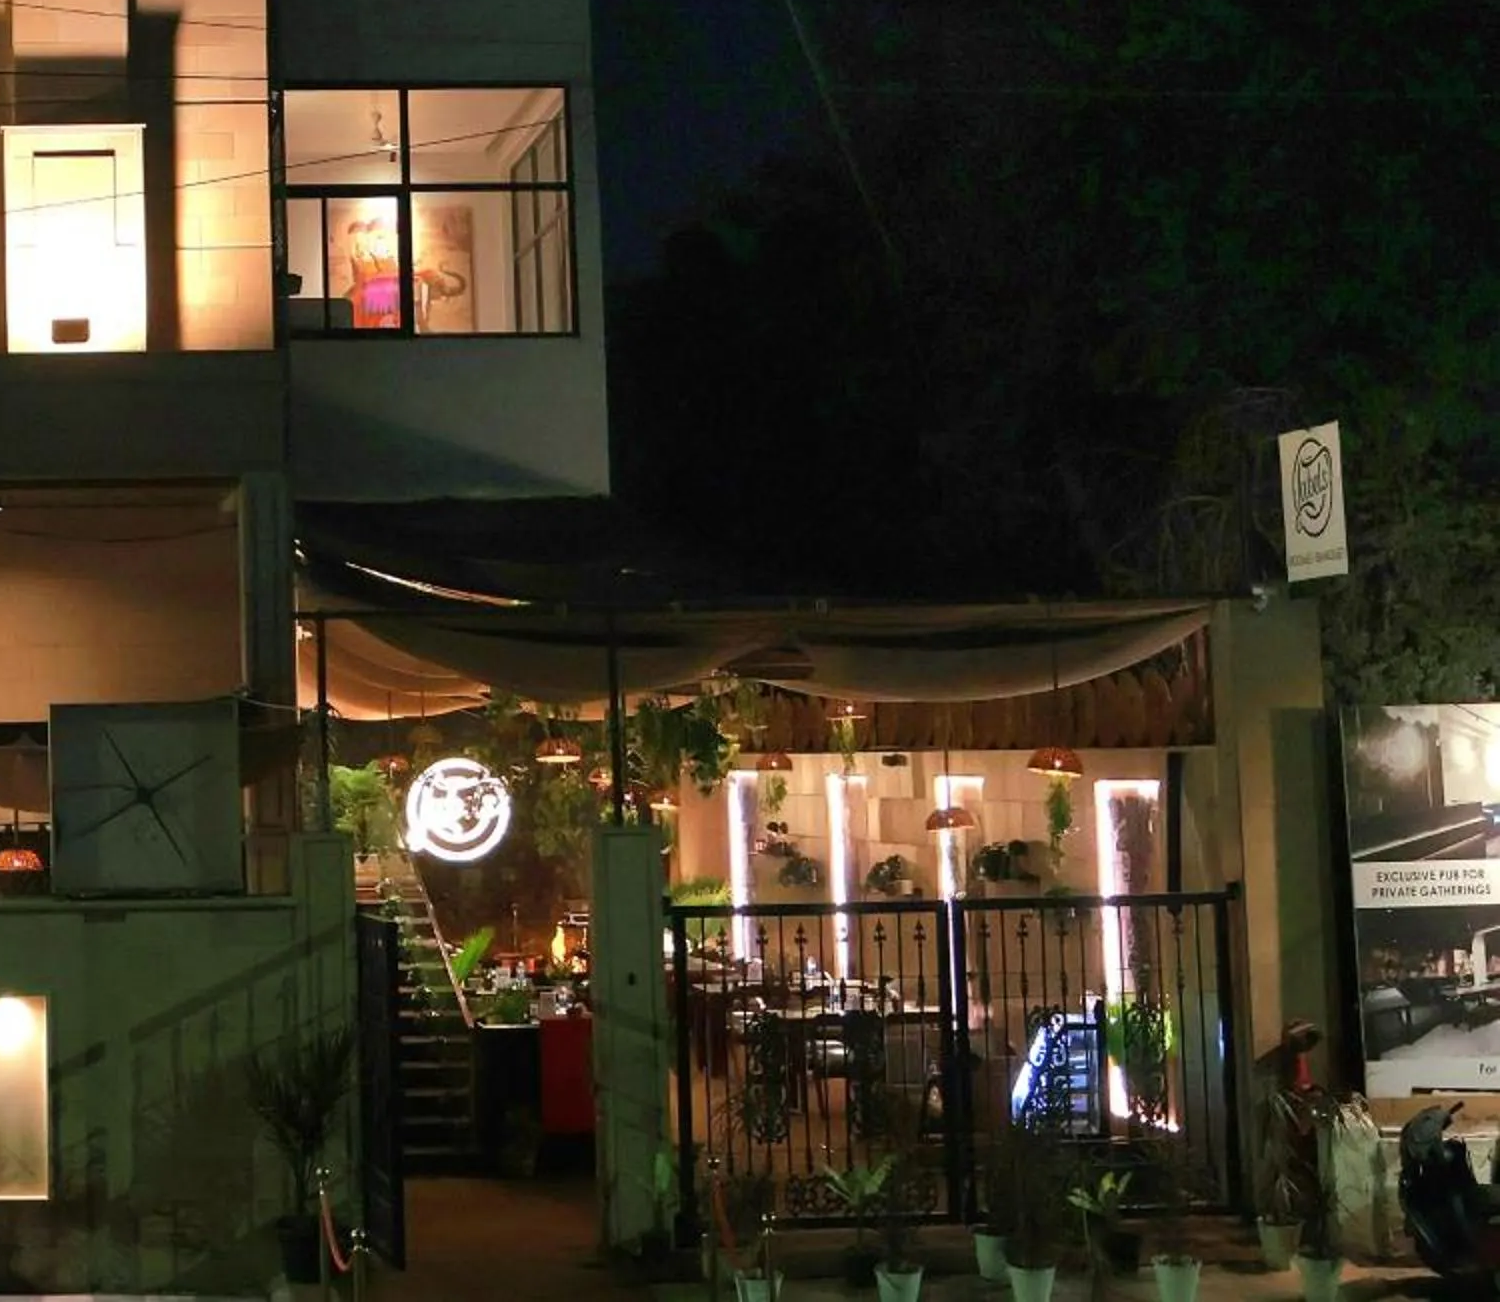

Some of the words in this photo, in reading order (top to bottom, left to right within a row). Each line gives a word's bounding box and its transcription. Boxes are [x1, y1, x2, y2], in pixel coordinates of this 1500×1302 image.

[1376, 870, 1436, 883] EXCLUSIVE
[1440, 869, 1460, 881] PUB
[1463, 869, 1485, 880] FOR
[1371, 886, 1418, 898] PRIVATE
[1419, 884, 1492, 897] GATHERINGS
[1479, 1062, 1497, 1075] For
